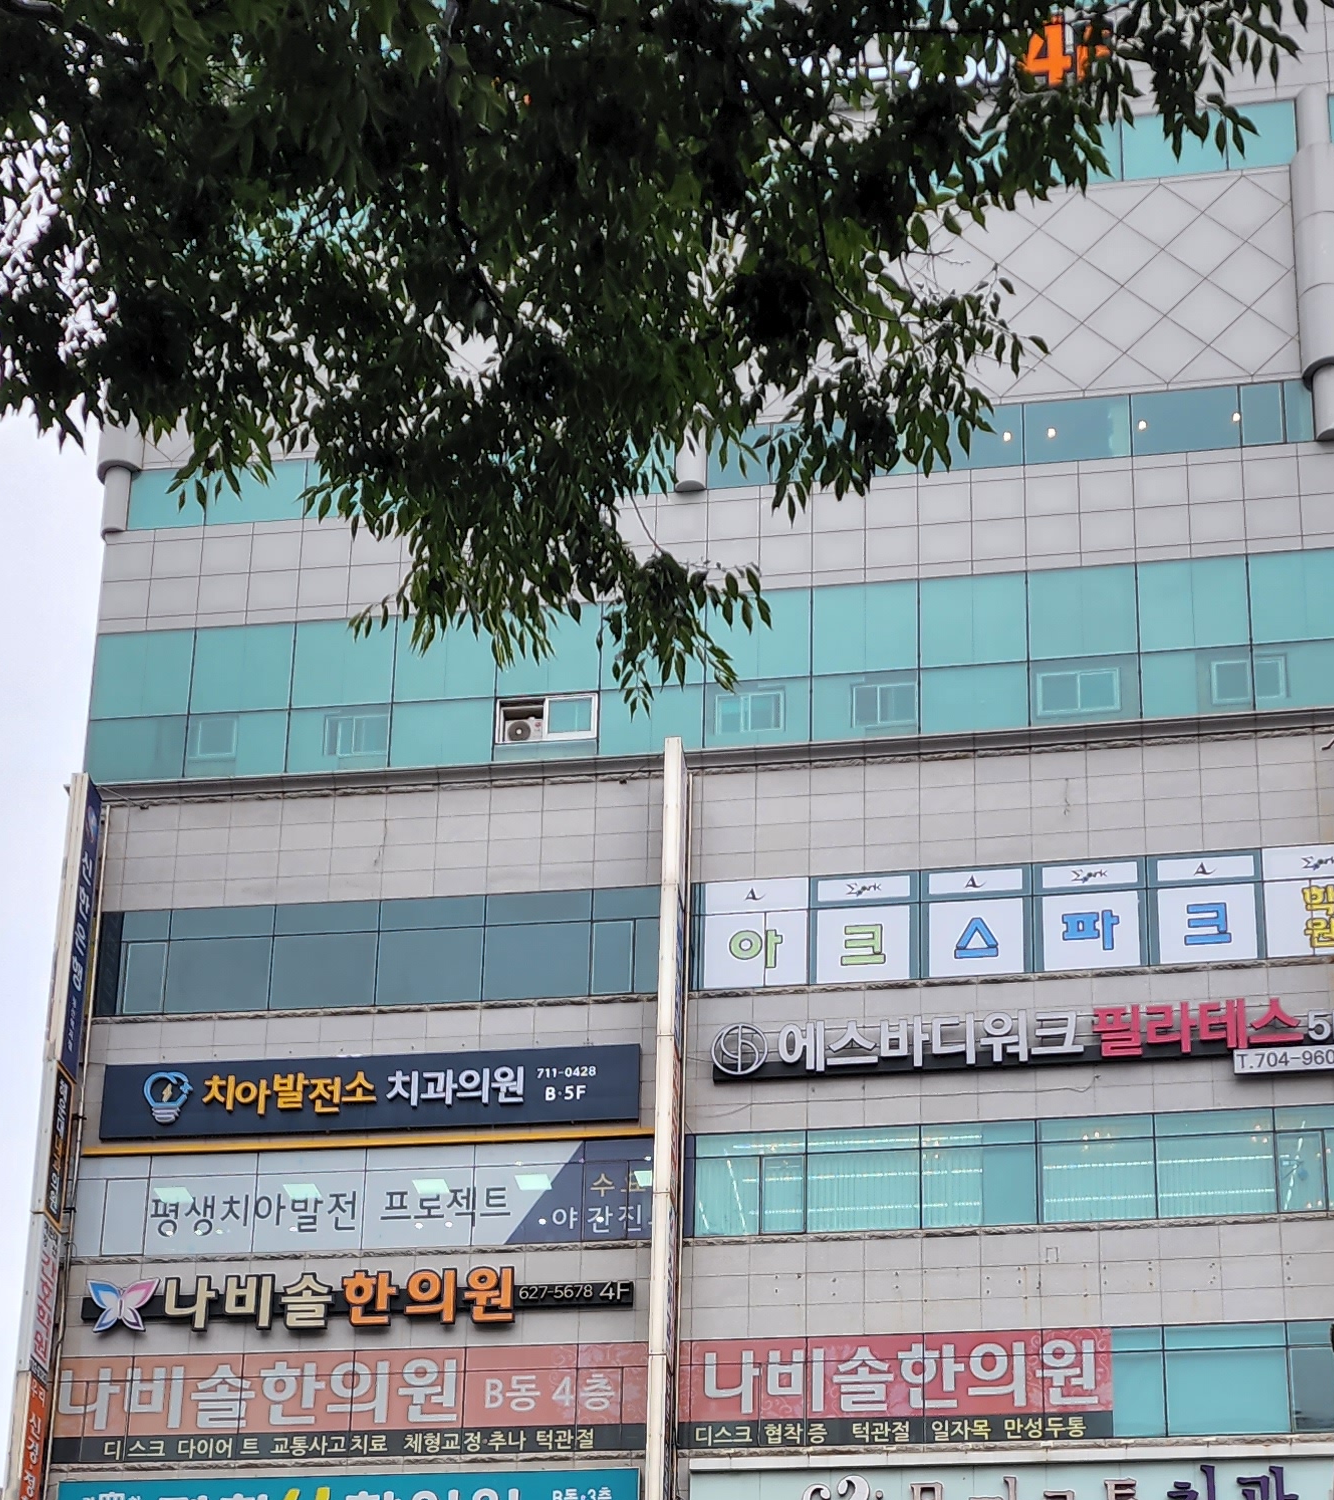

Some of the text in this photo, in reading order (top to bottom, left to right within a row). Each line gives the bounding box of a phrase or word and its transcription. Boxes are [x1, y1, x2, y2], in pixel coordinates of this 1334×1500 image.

[72, 850, 95, 992] 신한은행
[777, 1009, 1085, 1075] 에스바디워크
[1090, 998, 1306, 1058] 필라테스
[202, 1064, 526, 1115] 치아발전소 치과의원
[536, 1065, 597, 1079] 711-0428
[149, 1184, 511, 1238] 평생치아발전 프로젝트
[518, 1283, 594, 1301] 627-5678
[598, 1281, 630, 1300] 4F
[59, 1356, 458, 1432] 나비솔한의원
[483, 1375, 541, 1413] B동
[702, 1338, 1100, 1415] 나비솔한의원
[103, 1440, 166, 1460] 디스크
[176, 1437, 260, 1459] 다이어트
[270, 1433, 388, 1456] 교통사고치료
[535, 1427, 595, 1450] 턱관절
[694, 1415, 1087, 1444] 디스크 협착증 턱관절 일자목 만성두통
